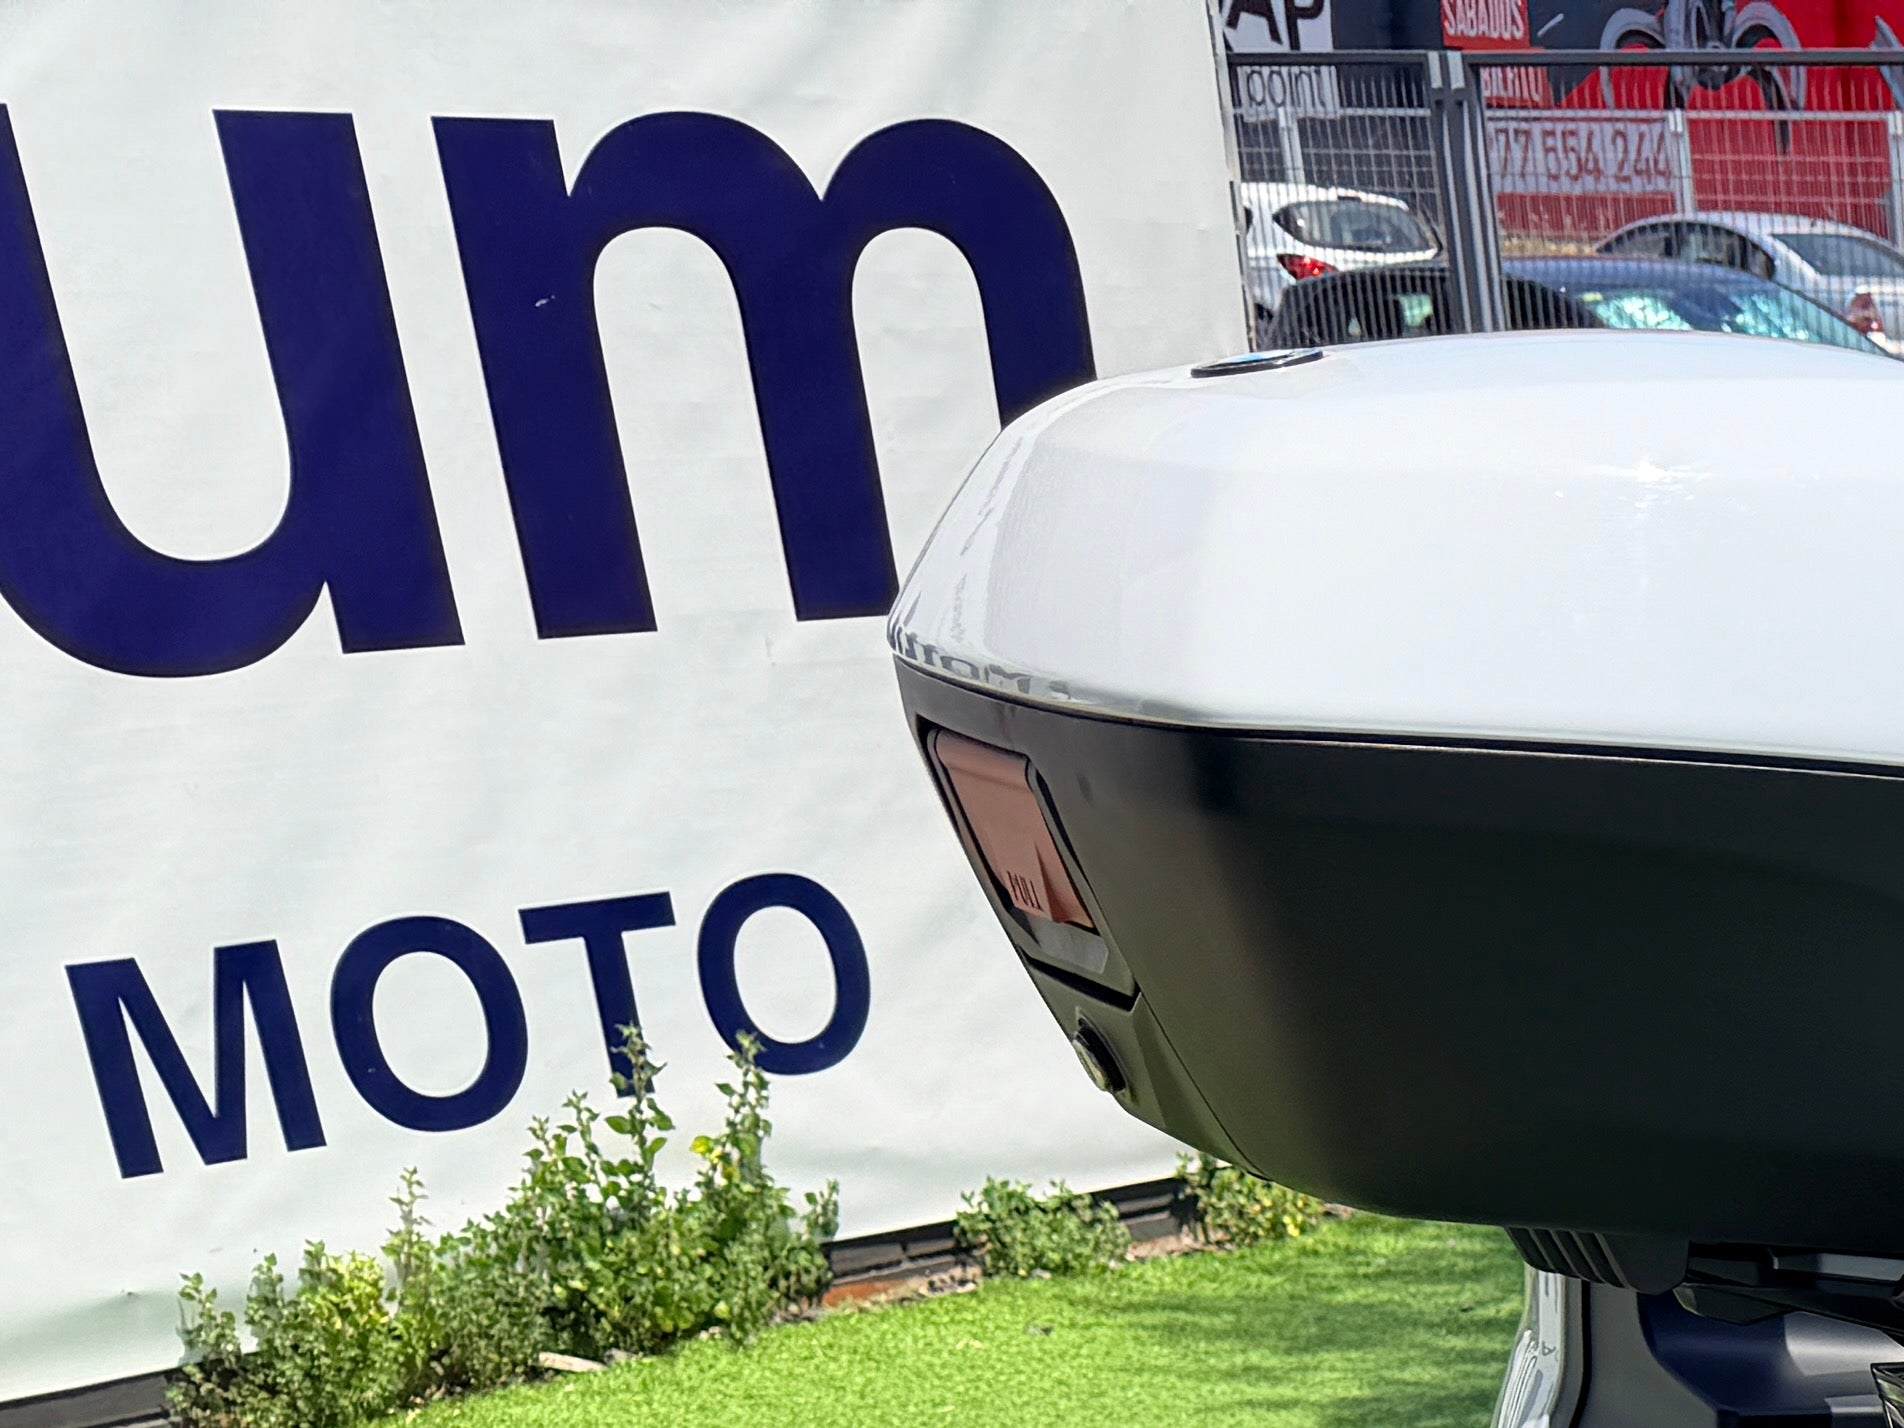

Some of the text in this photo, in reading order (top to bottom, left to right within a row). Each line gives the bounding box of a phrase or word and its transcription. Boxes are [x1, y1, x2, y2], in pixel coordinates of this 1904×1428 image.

[1541, 128, 1603, 184] 554
[1611, 129, 1673, 189] 244
[1005, 868, 1044, 913] PULL
[65, 872, 872, 1179] MOTO
